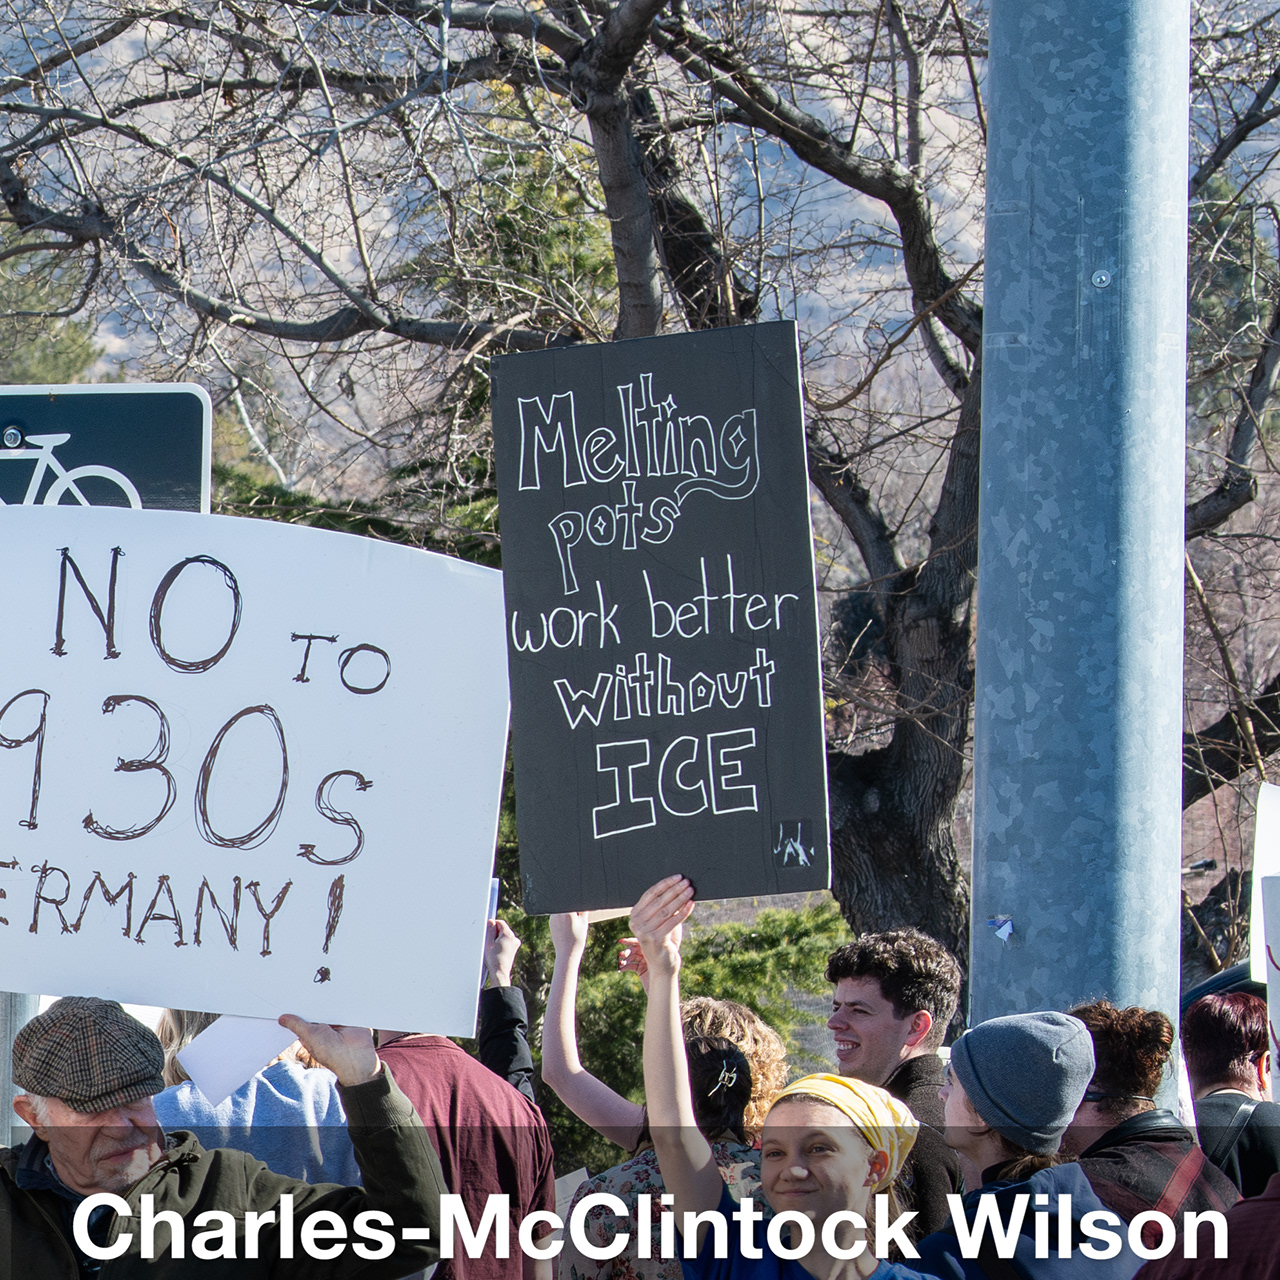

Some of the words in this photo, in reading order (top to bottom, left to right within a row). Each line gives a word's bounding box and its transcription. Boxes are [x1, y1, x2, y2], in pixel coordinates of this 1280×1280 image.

[518, 372, 760, 503] Melting
[548, 480, 681, 595] pots
[50, 546, 242, 674] NO
[290, 631, 391, 695] TO
[512, 580, 622, 652] work
[643, 553, 799, 640] better
[554, 648, 776, 729] without
[592, 727, 760, 839] ICE
